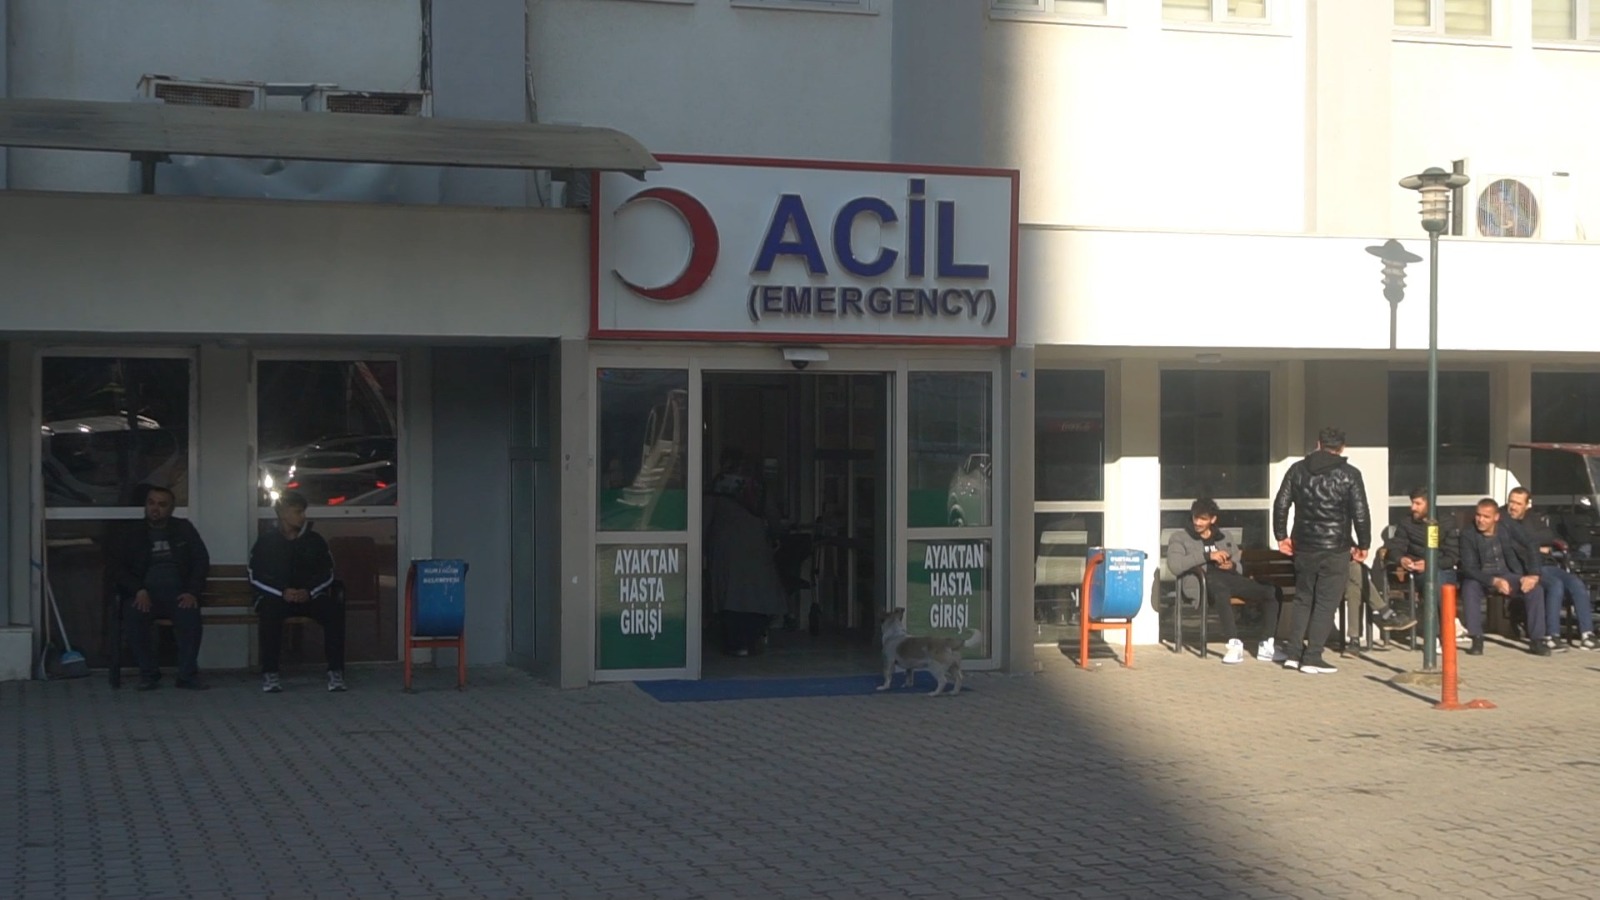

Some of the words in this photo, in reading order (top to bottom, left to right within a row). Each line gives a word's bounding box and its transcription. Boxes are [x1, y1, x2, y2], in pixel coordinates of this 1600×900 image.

[750, 178, 990, 279] ACİL
[747, 284, 997, 325] (EMERGENCY)
[615, 547, 679, 575] AYAKTAN
[924, 543, 985, 570] AYAKTAN
[619, 577, 665, 603] HASTA
[930, 571, 973, 597] HASTA
[620, 602, 663, 640] GİRİŞİ
[929, 597, 970, 634] GİRİŞİ
